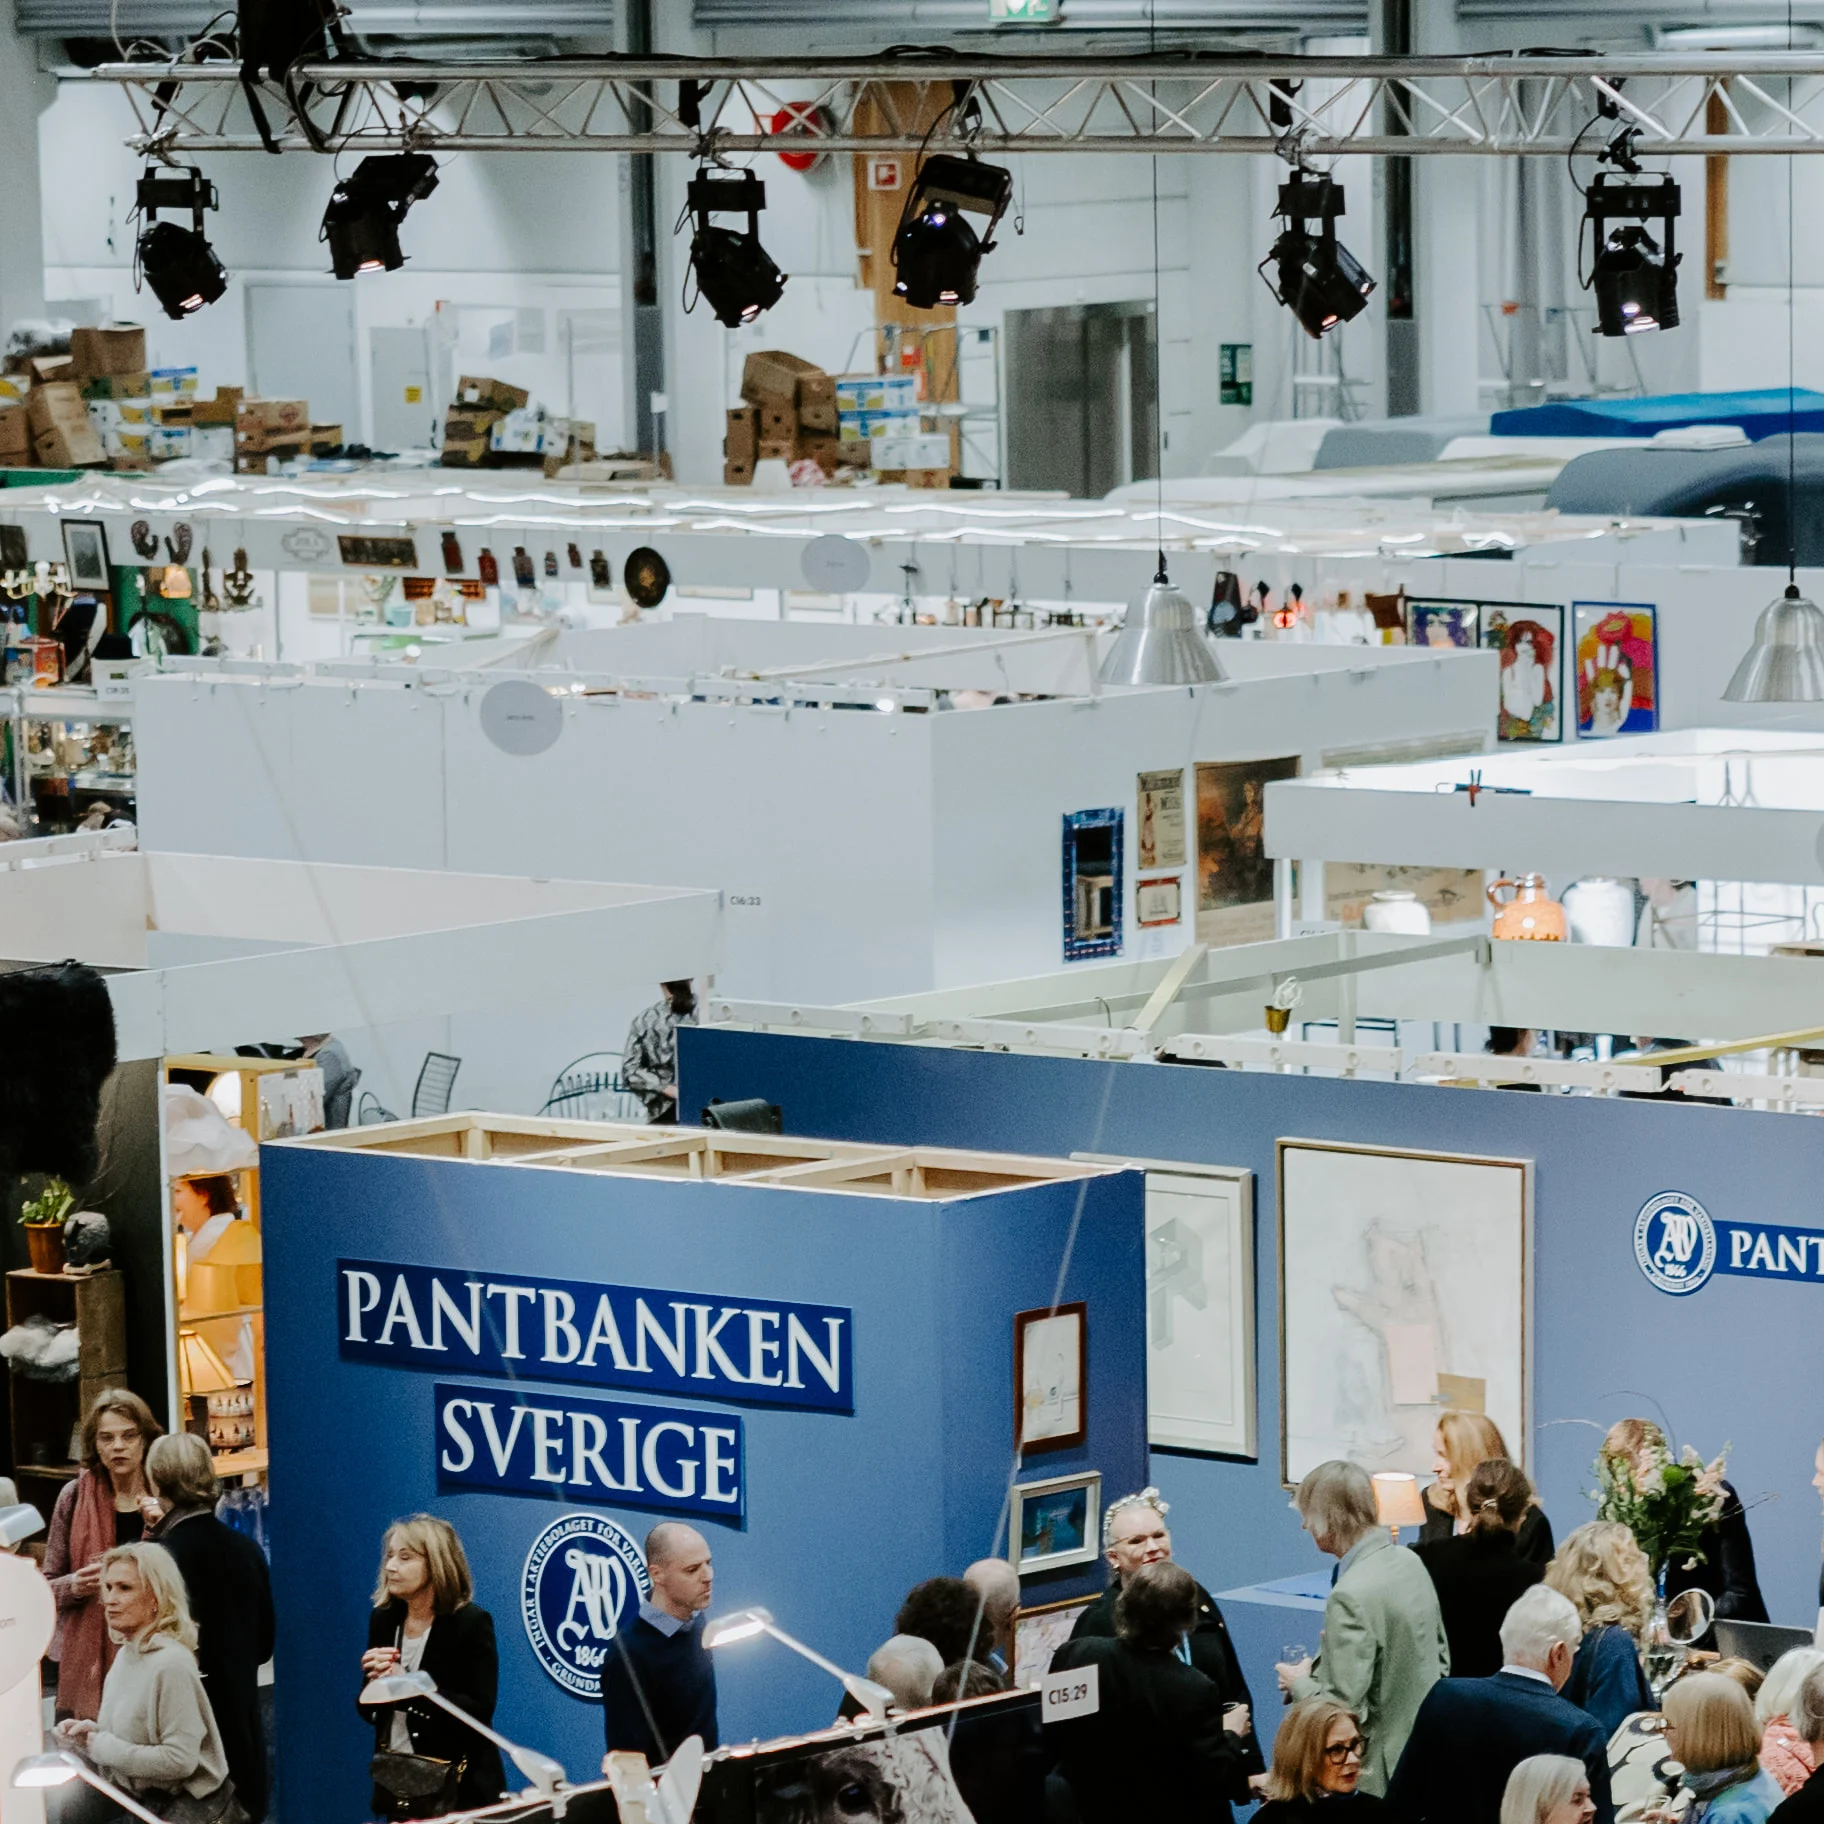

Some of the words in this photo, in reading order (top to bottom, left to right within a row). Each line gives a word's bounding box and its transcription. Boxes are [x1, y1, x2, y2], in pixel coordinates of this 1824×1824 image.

[341, 1269, 845, 1393] PANTBANKEN
[440, 1395, 739, 1503] SVERIGE
[528, 1519, 594, 1583] AKTIEBOLAGET
[1048, 1683, 1088, 1705] C15:29
